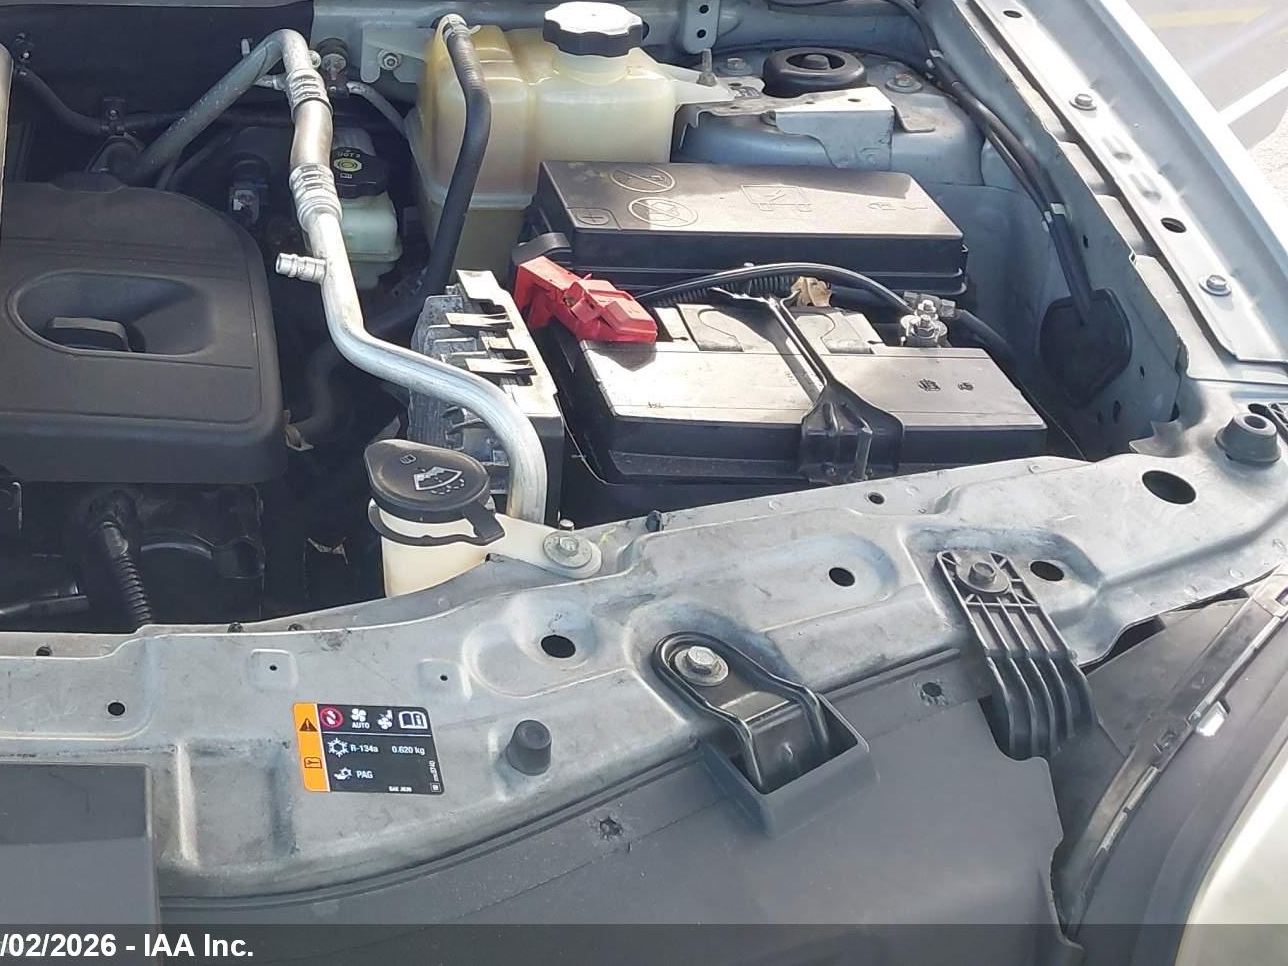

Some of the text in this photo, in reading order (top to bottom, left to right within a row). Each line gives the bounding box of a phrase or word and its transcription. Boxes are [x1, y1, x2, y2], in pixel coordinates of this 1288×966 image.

[350, 744, 379, 753] R-134a
[414, 746, 425, 756] kg
[356, 770, 374, 779] PAG
